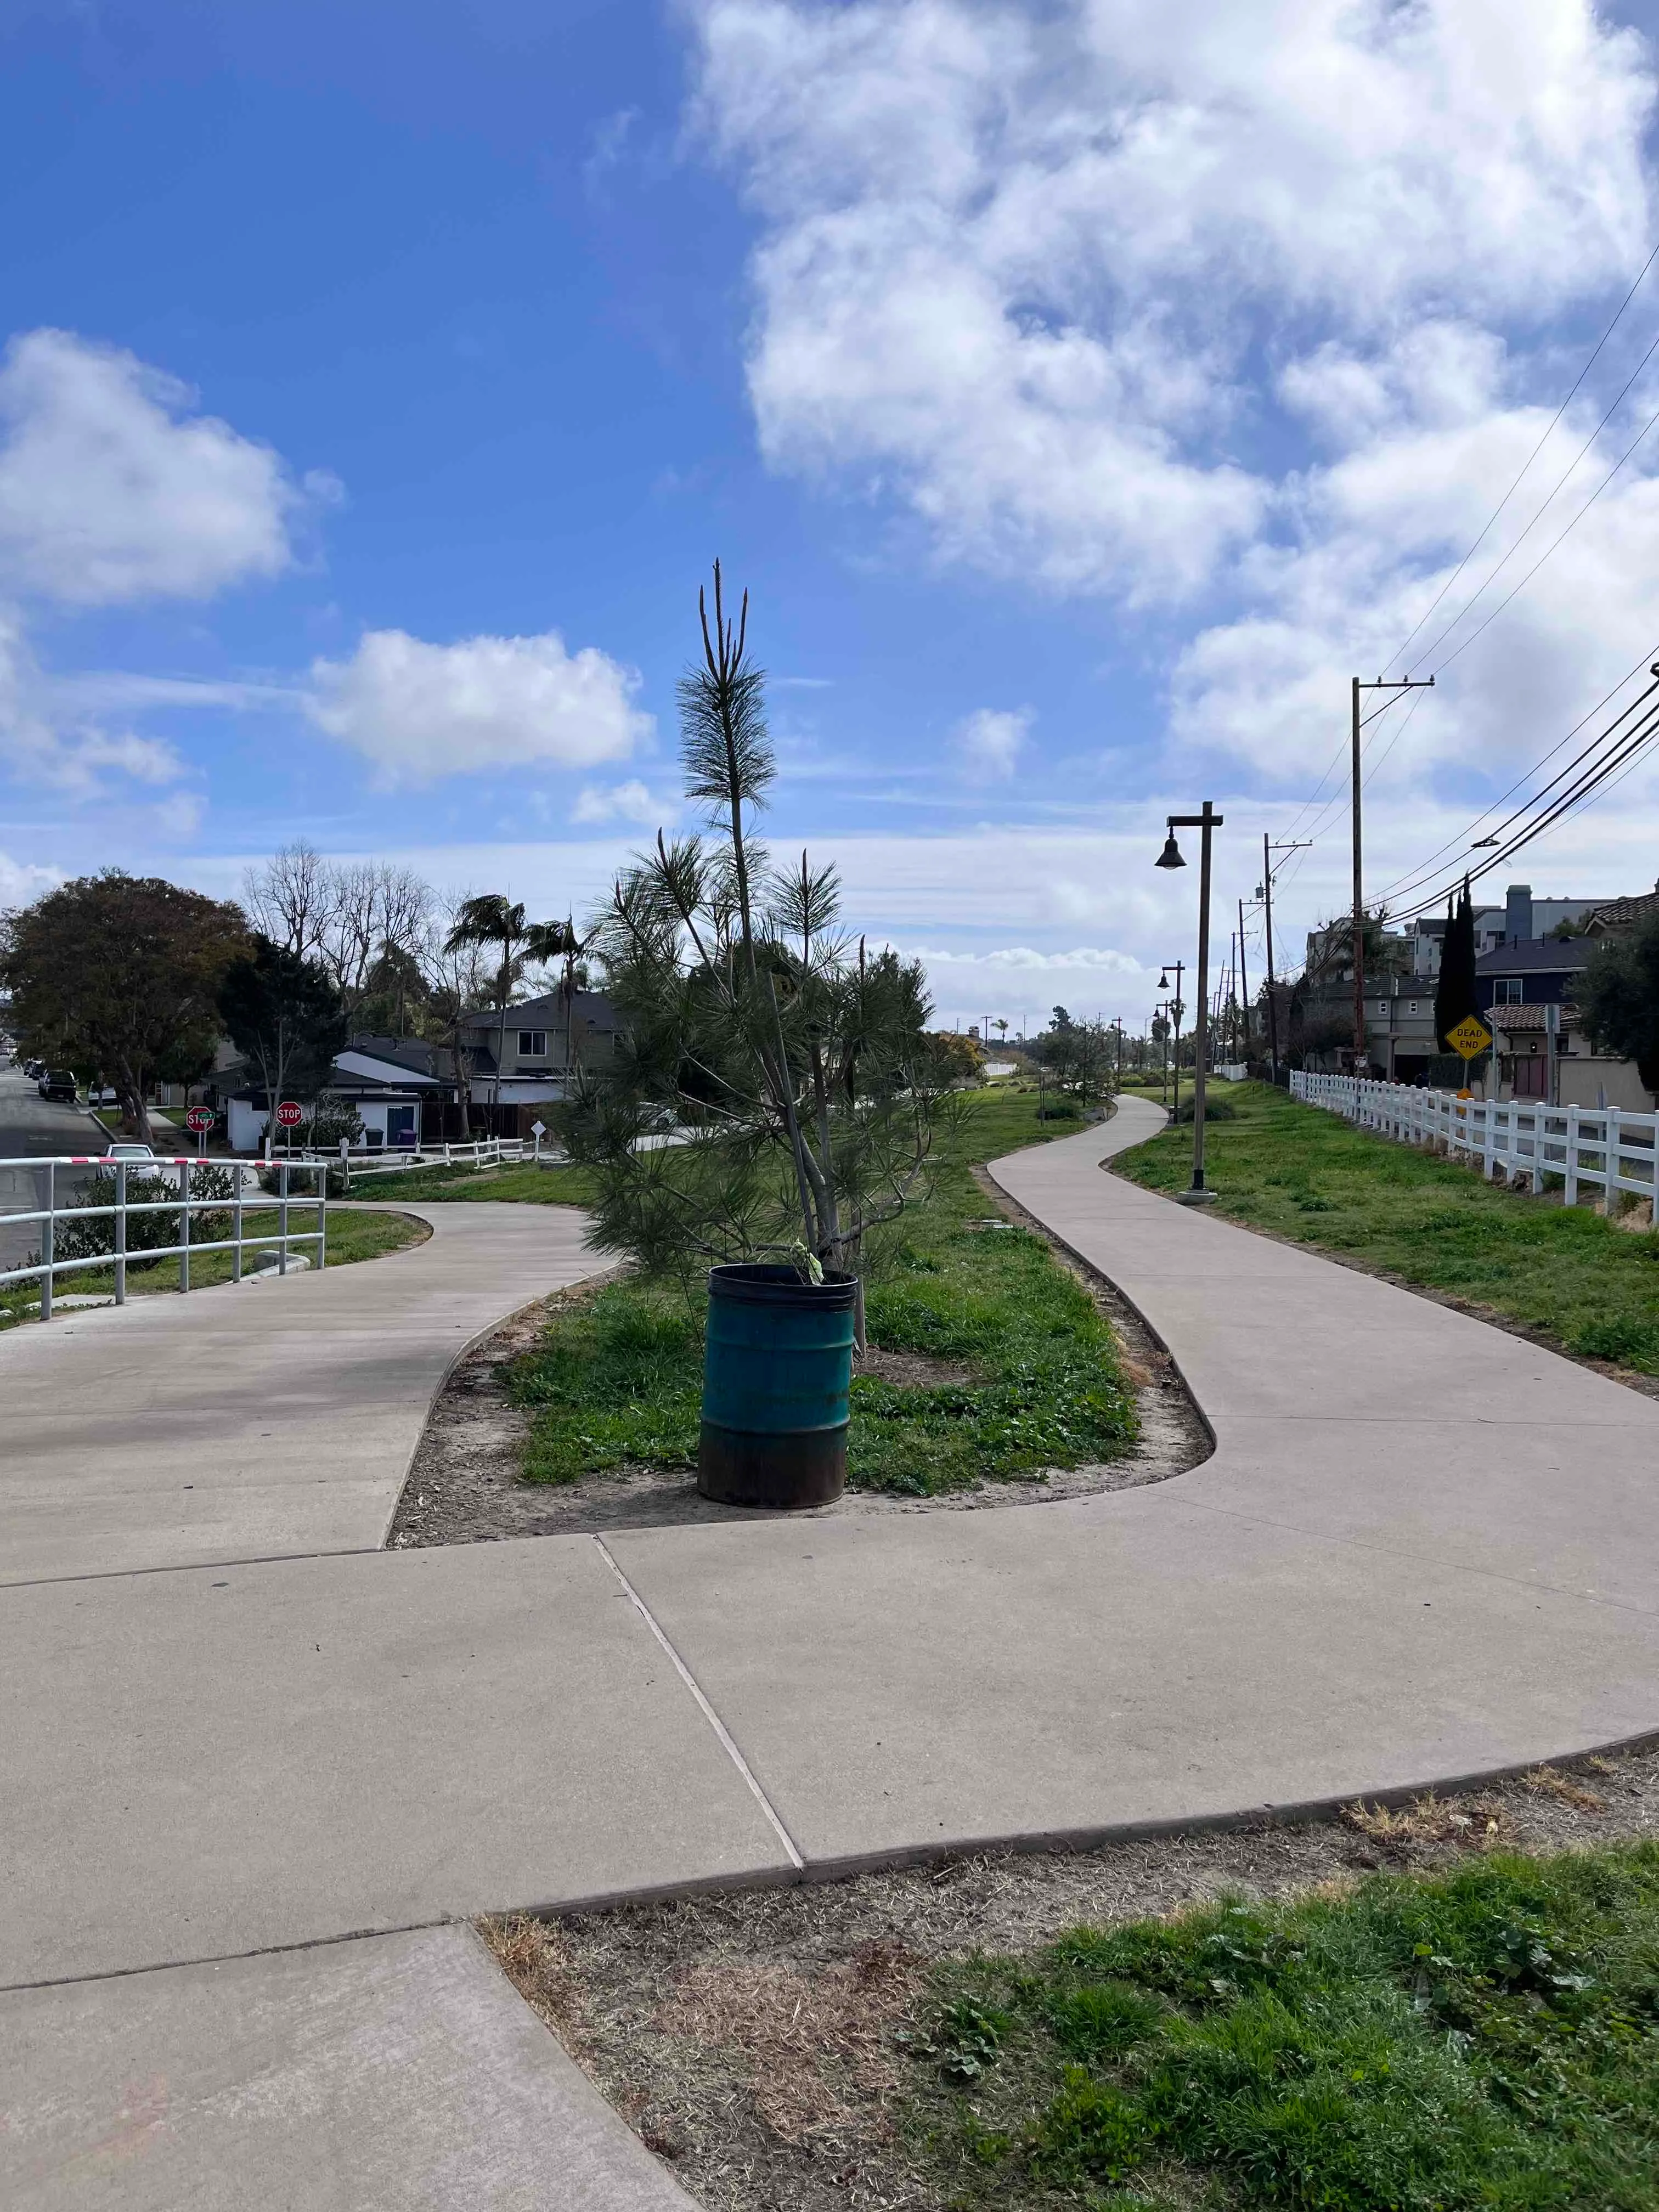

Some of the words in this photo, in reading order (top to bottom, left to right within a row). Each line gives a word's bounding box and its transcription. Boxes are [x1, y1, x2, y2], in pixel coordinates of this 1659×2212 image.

[1457, 1029, 1482, 1037] DEAD
[1460, 1040, 1478, 1048] END
[278, 1109, 301, 1119] STOP
